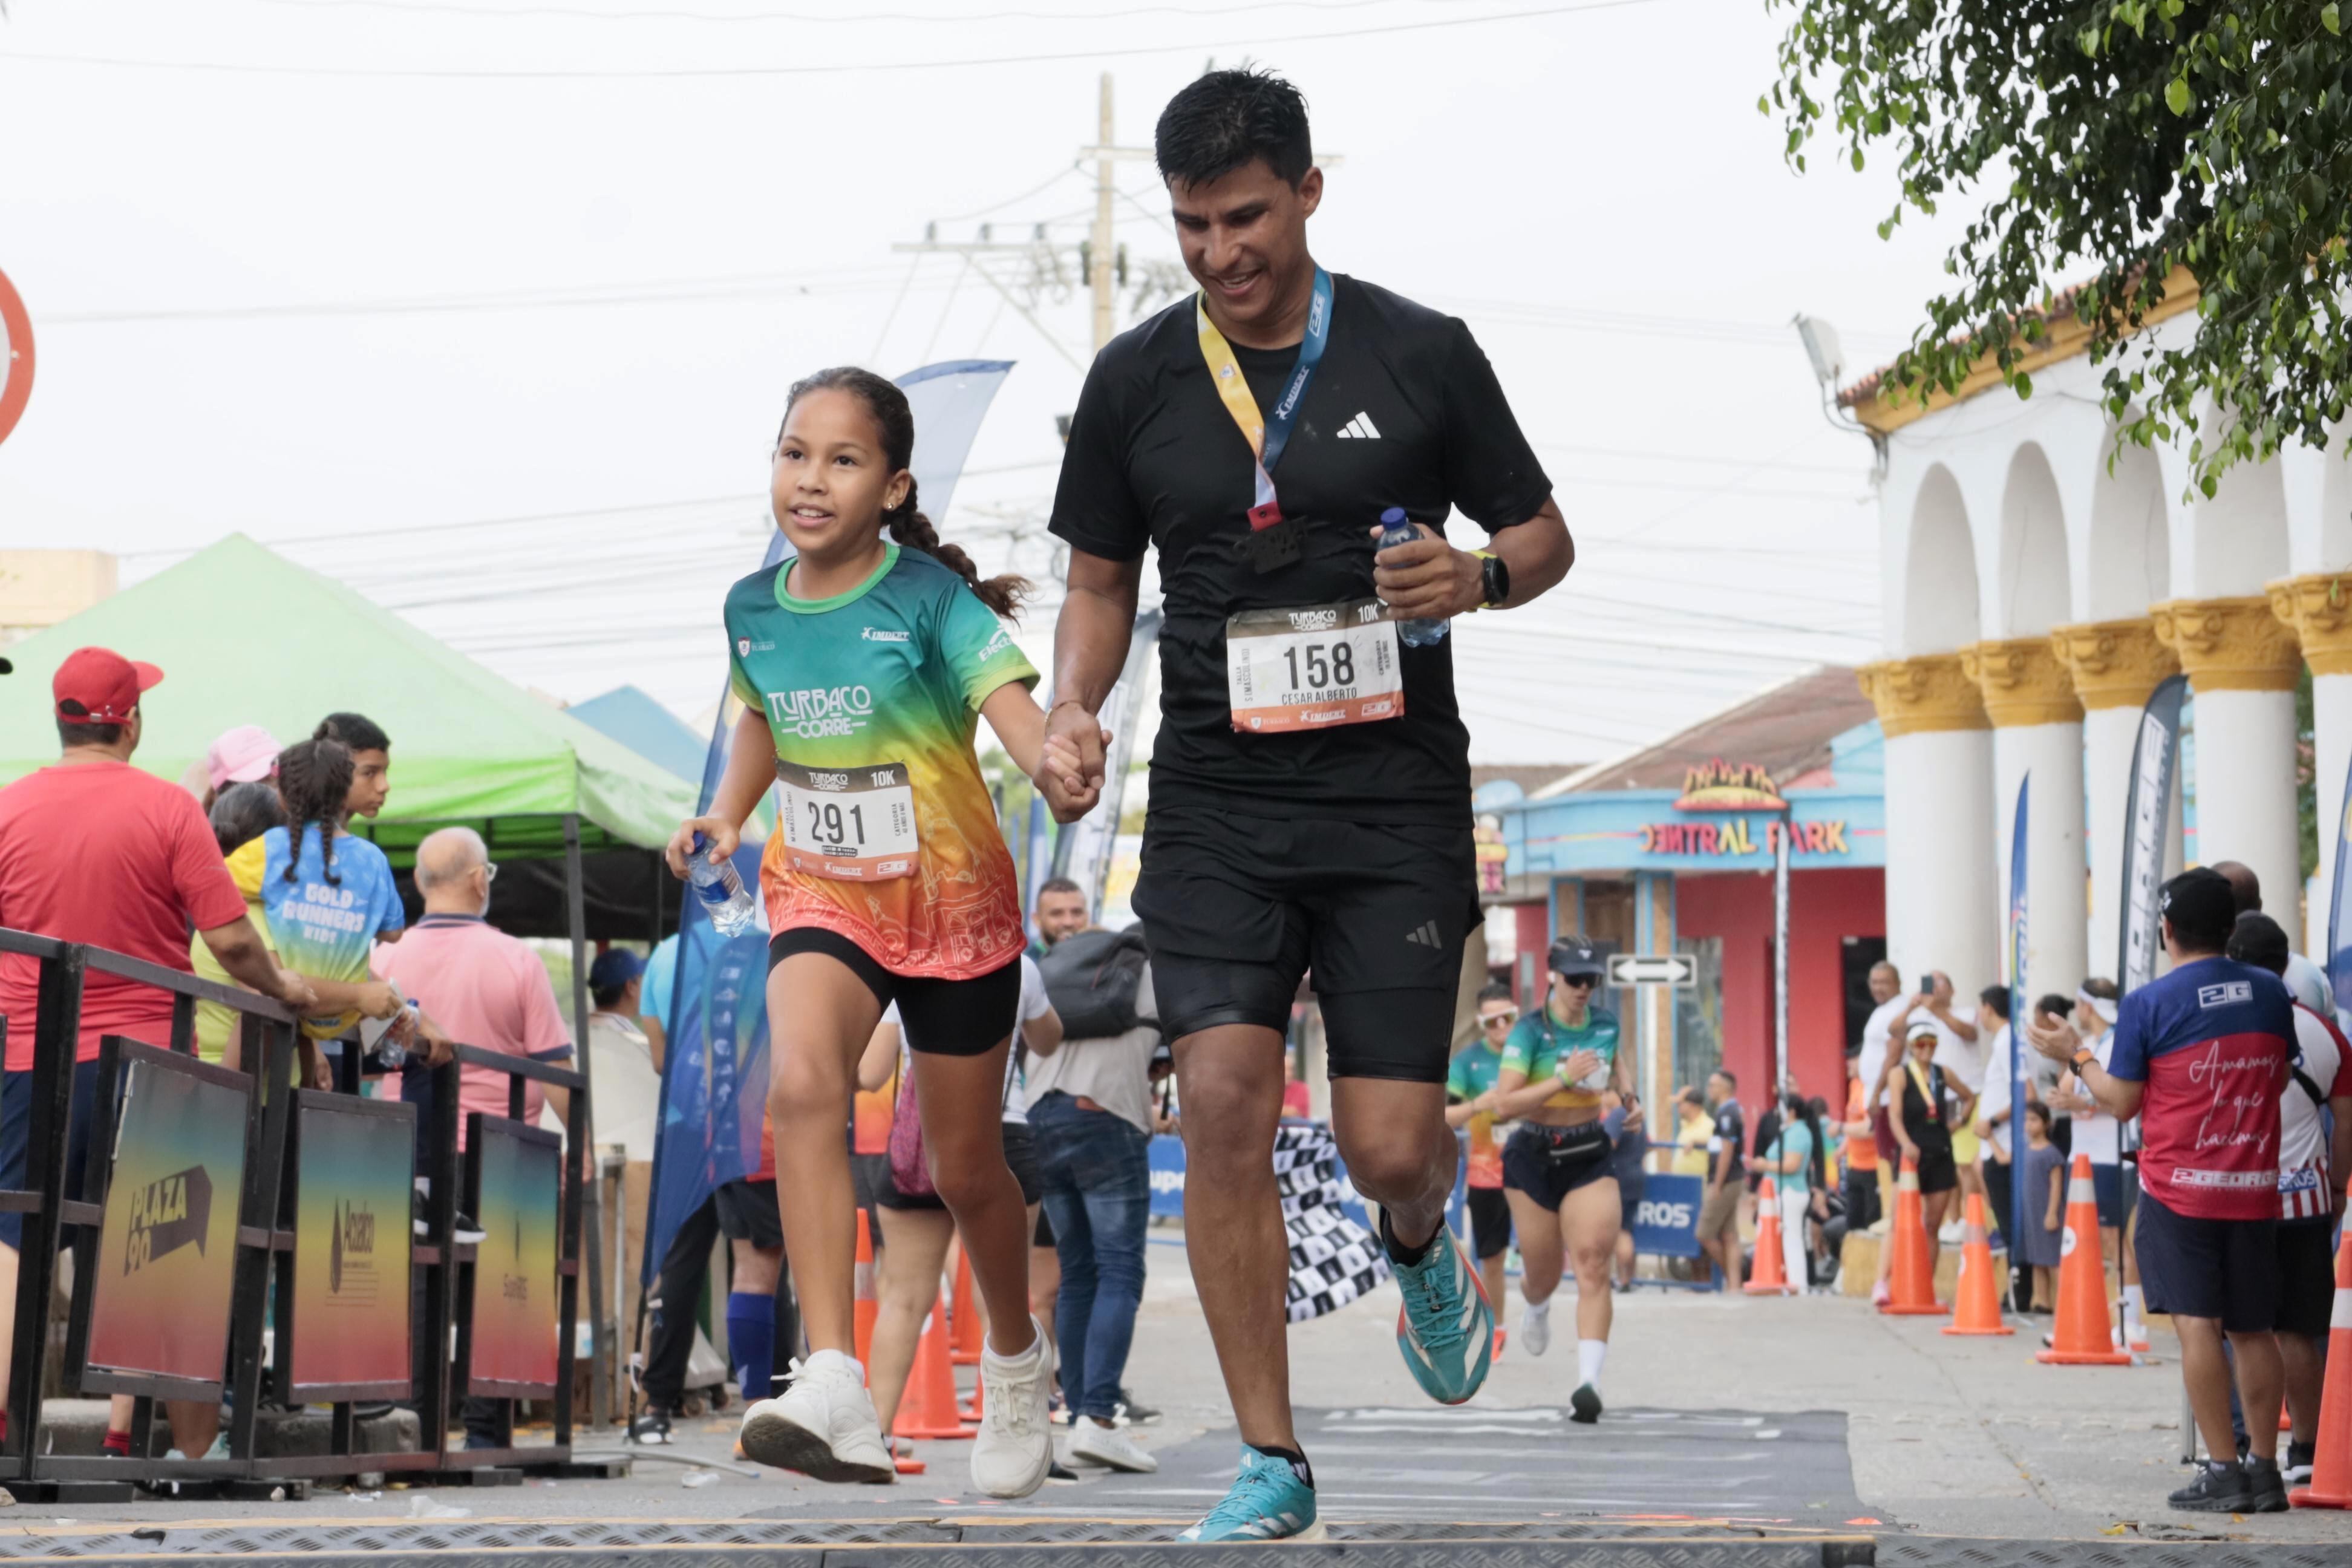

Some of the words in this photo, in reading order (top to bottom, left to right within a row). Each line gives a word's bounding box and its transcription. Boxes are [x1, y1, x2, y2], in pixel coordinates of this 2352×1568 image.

[1289, 610, 1336, 626] TURBACO
[1358, 604, 1379, 622] 10K
[871, 630, 909, 641] IMDERT
[1284, 642, 1354, 690] 158
[768, 685, 873, 722] TURBACO
[1282, 693, 1316, 705] CESAR
[1316, 687, 1357, 702] ALBERTO
[797, 717, 854, 738] CORRE
[1310, 709, 1345, 722] IMDERT
[809, 773, 848, 785] TURBACO
[871, 770, 895, 787] 10K
[808, 802, 864, 844] 291
[892, 803, 900, 836] CATEGORIA
[305, 883, 353, 908] GOLD
[283, 901, 365, 932] RUNNERS
[2198, 980, 2253, 1008] 2G
[2189, 1040, 2279, 1090] Amamos
[2209, 1079, 2227, 1121] lo
[2233, 1092, 2264, 1131] que
[2196, 1116, 2270, 1154] hacemos
[131, 1177, 187, 1231] PLAZA
